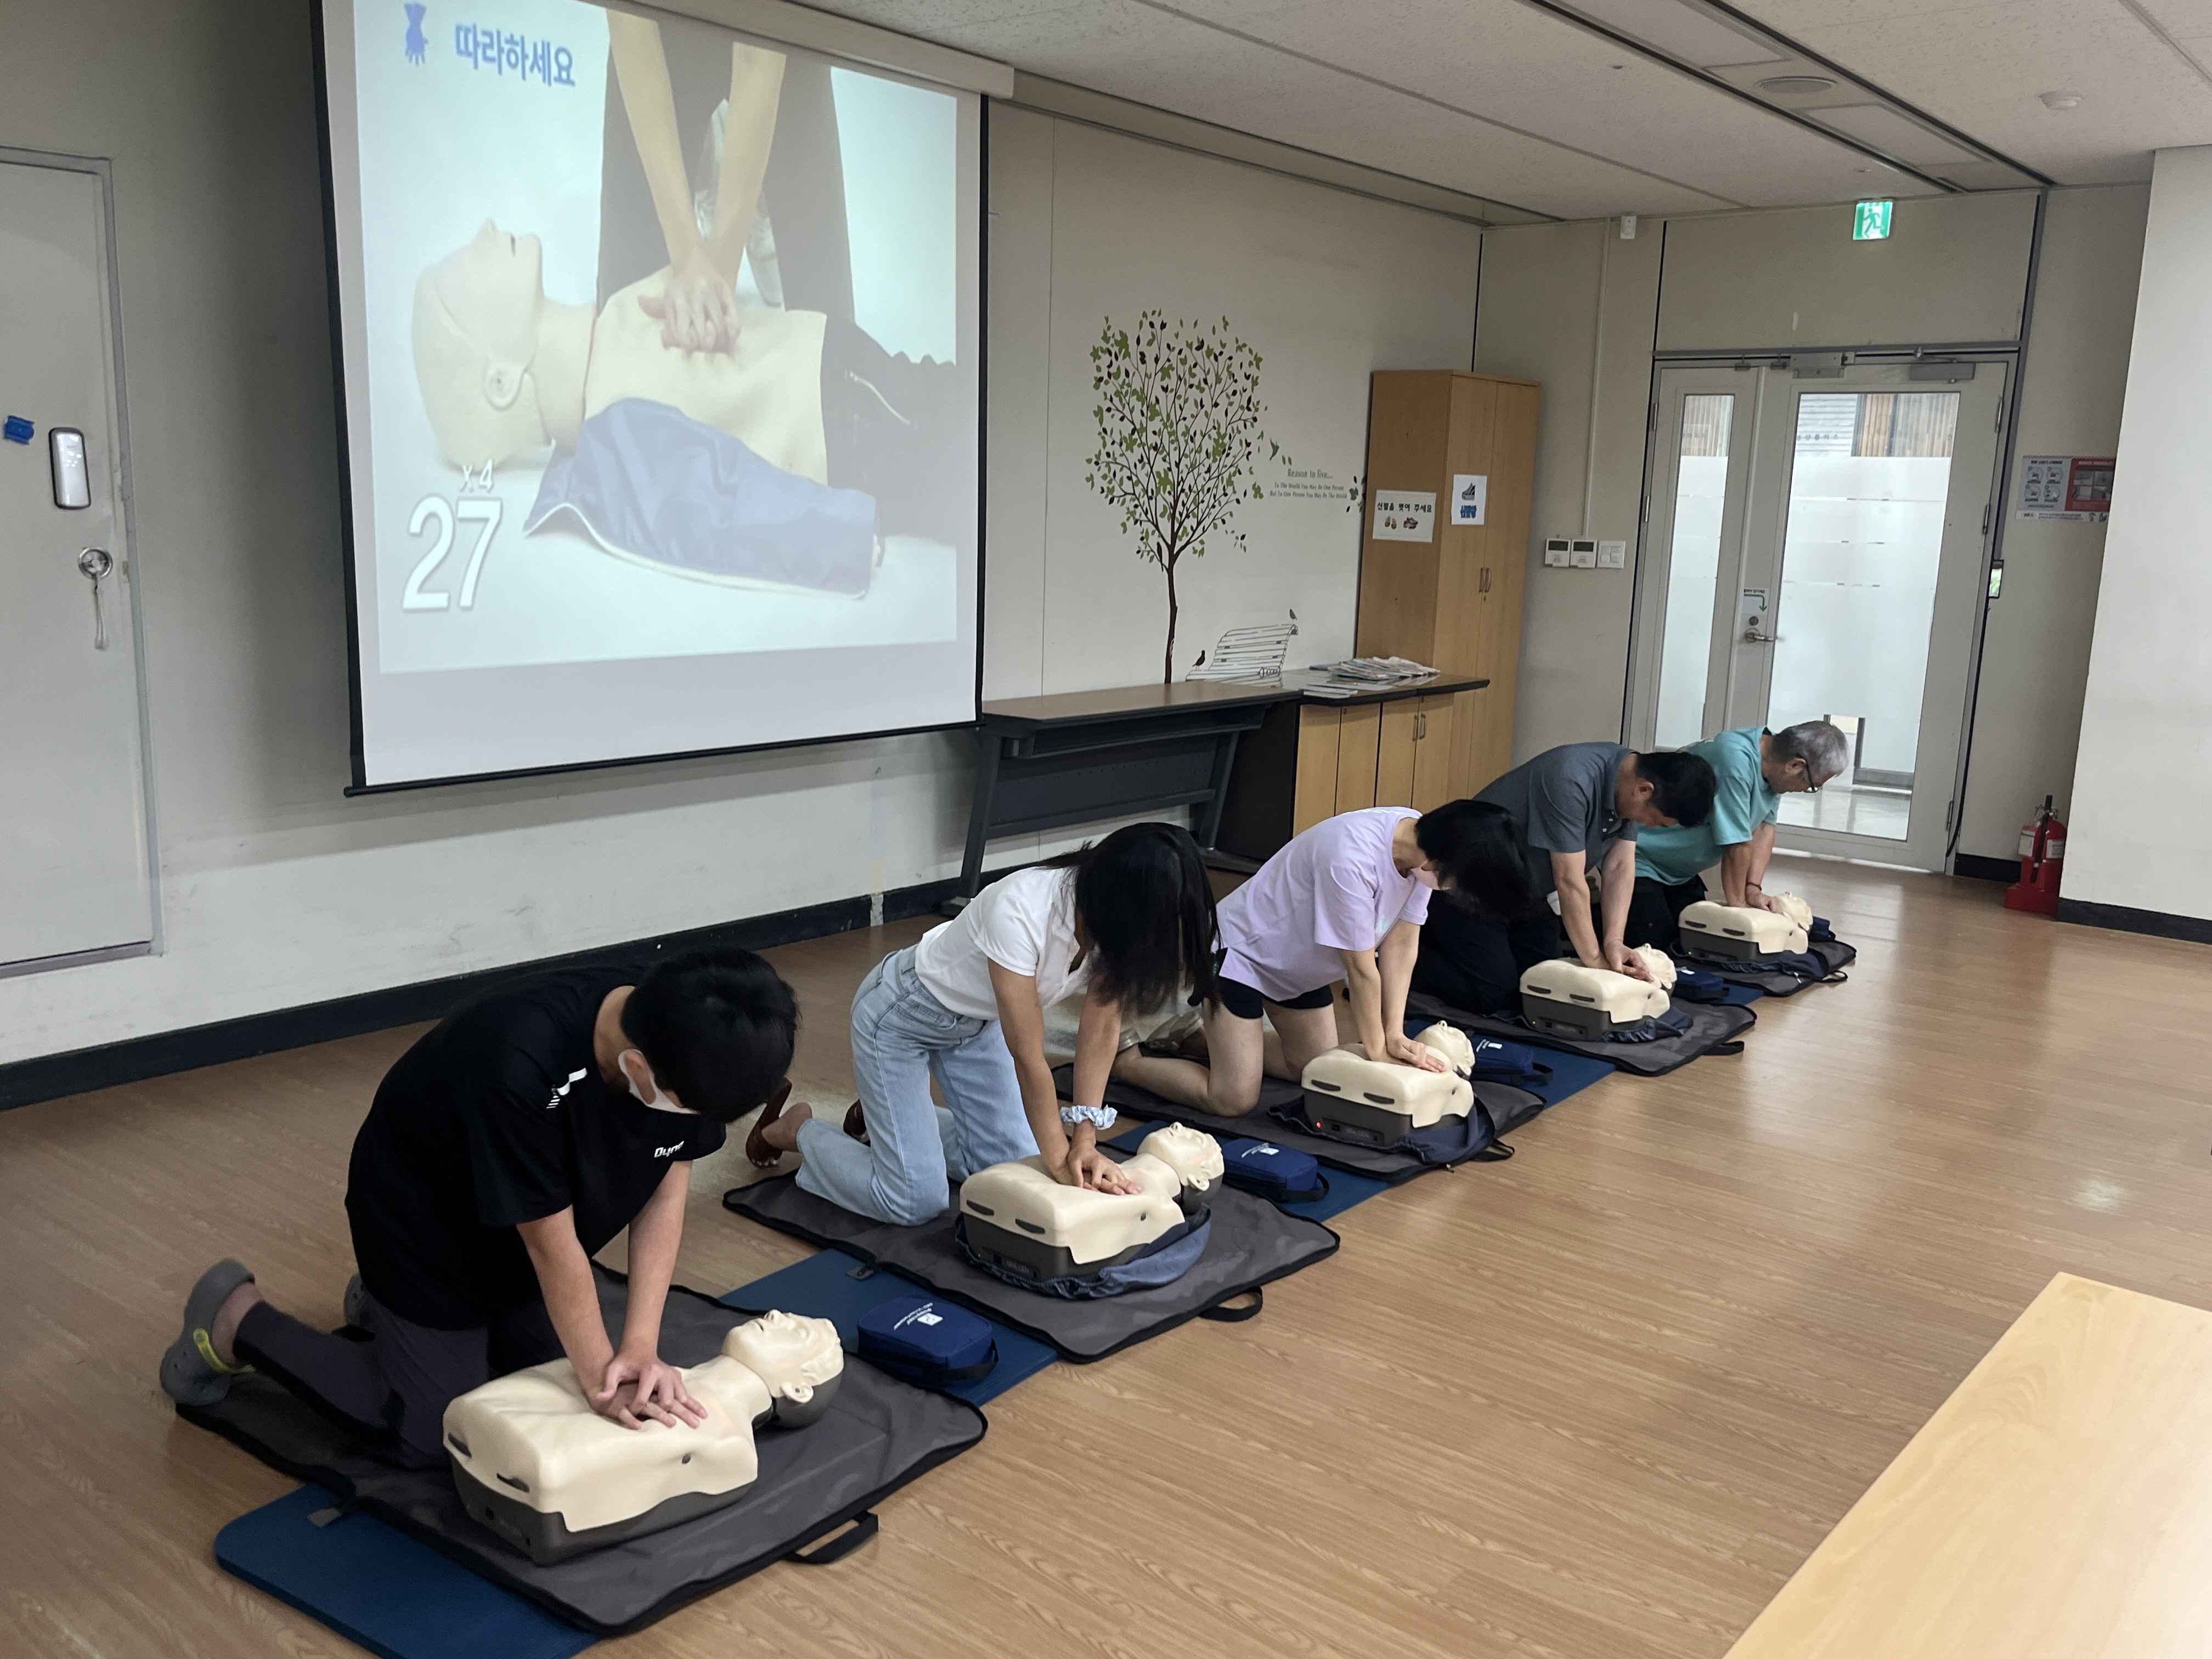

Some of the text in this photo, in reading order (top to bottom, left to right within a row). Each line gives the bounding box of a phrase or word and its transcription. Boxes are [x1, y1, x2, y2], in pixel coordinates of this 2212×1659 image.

[455, 22, 575, 87] 따라하세요
[1288, 468, 1307, 477] Reason
[1377, 502, 1432, 513] 신발을 벗어 주세요
[403, 493, 504, 612] 27
